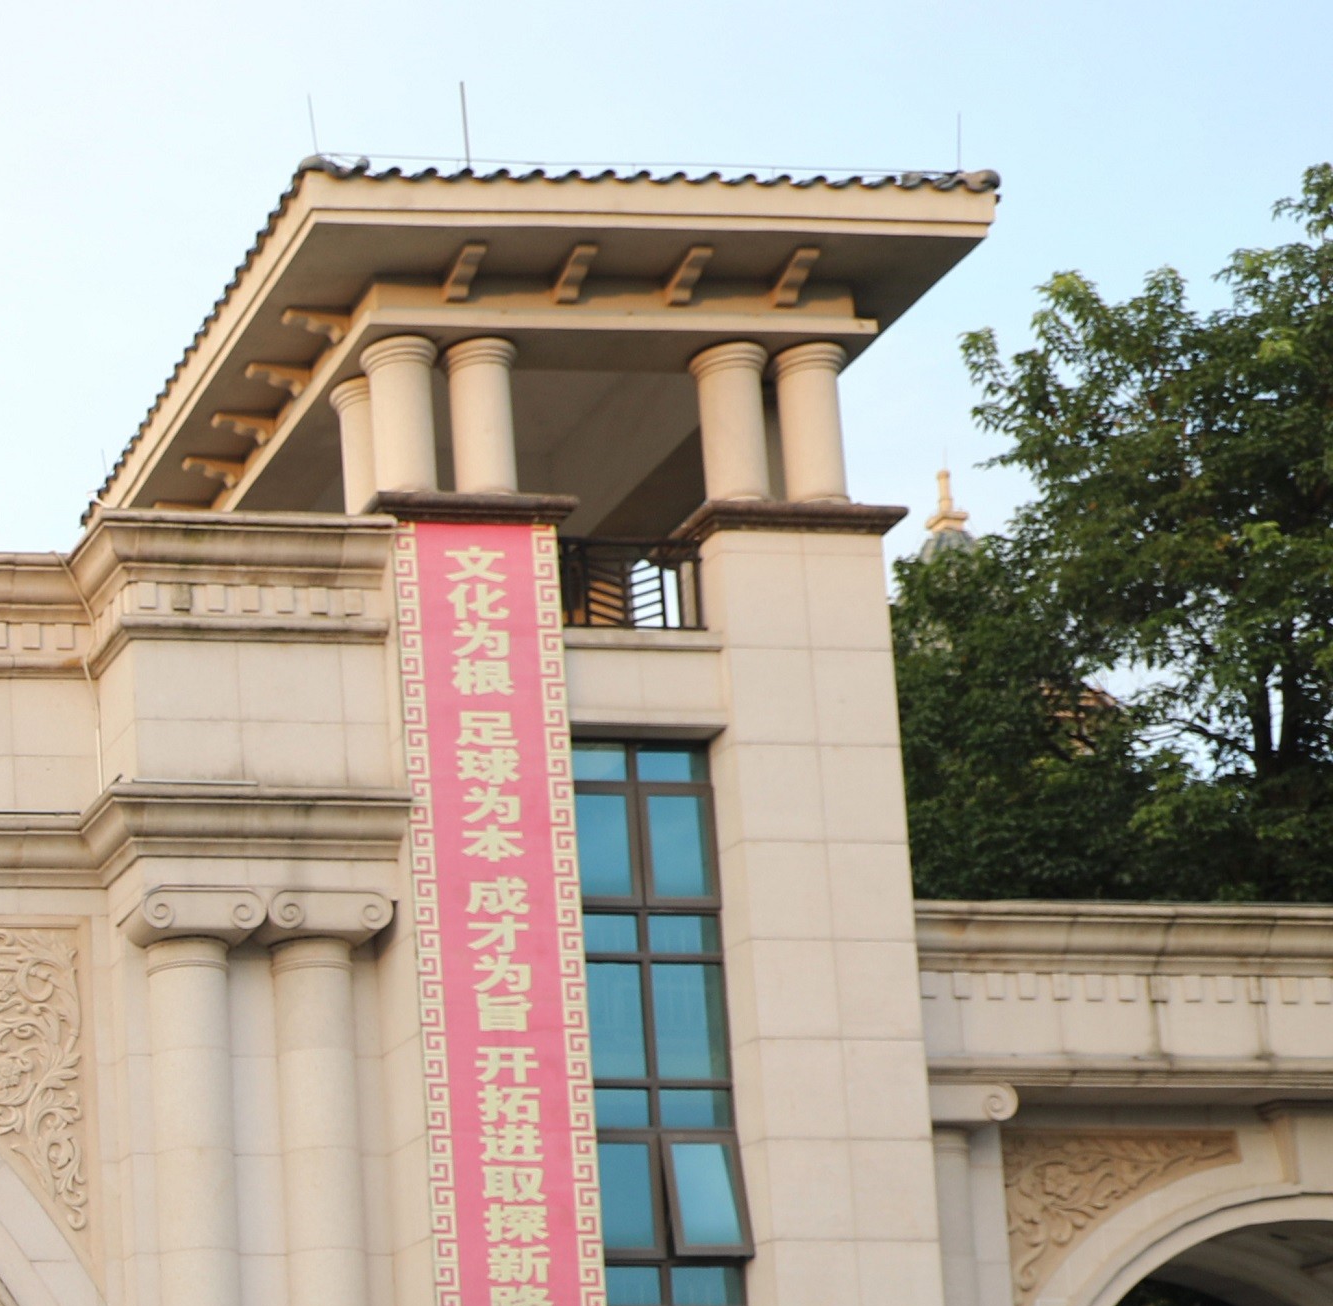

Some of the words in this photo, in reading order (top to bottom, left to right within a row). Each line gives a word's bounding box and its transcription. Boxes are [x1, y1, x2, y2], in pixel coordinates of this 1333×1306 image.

[444, 545, 515, 697] 文化为根
[456, 711, 525, 863] 足球为本
[465, 876, 534, 1032] 成才为旨
